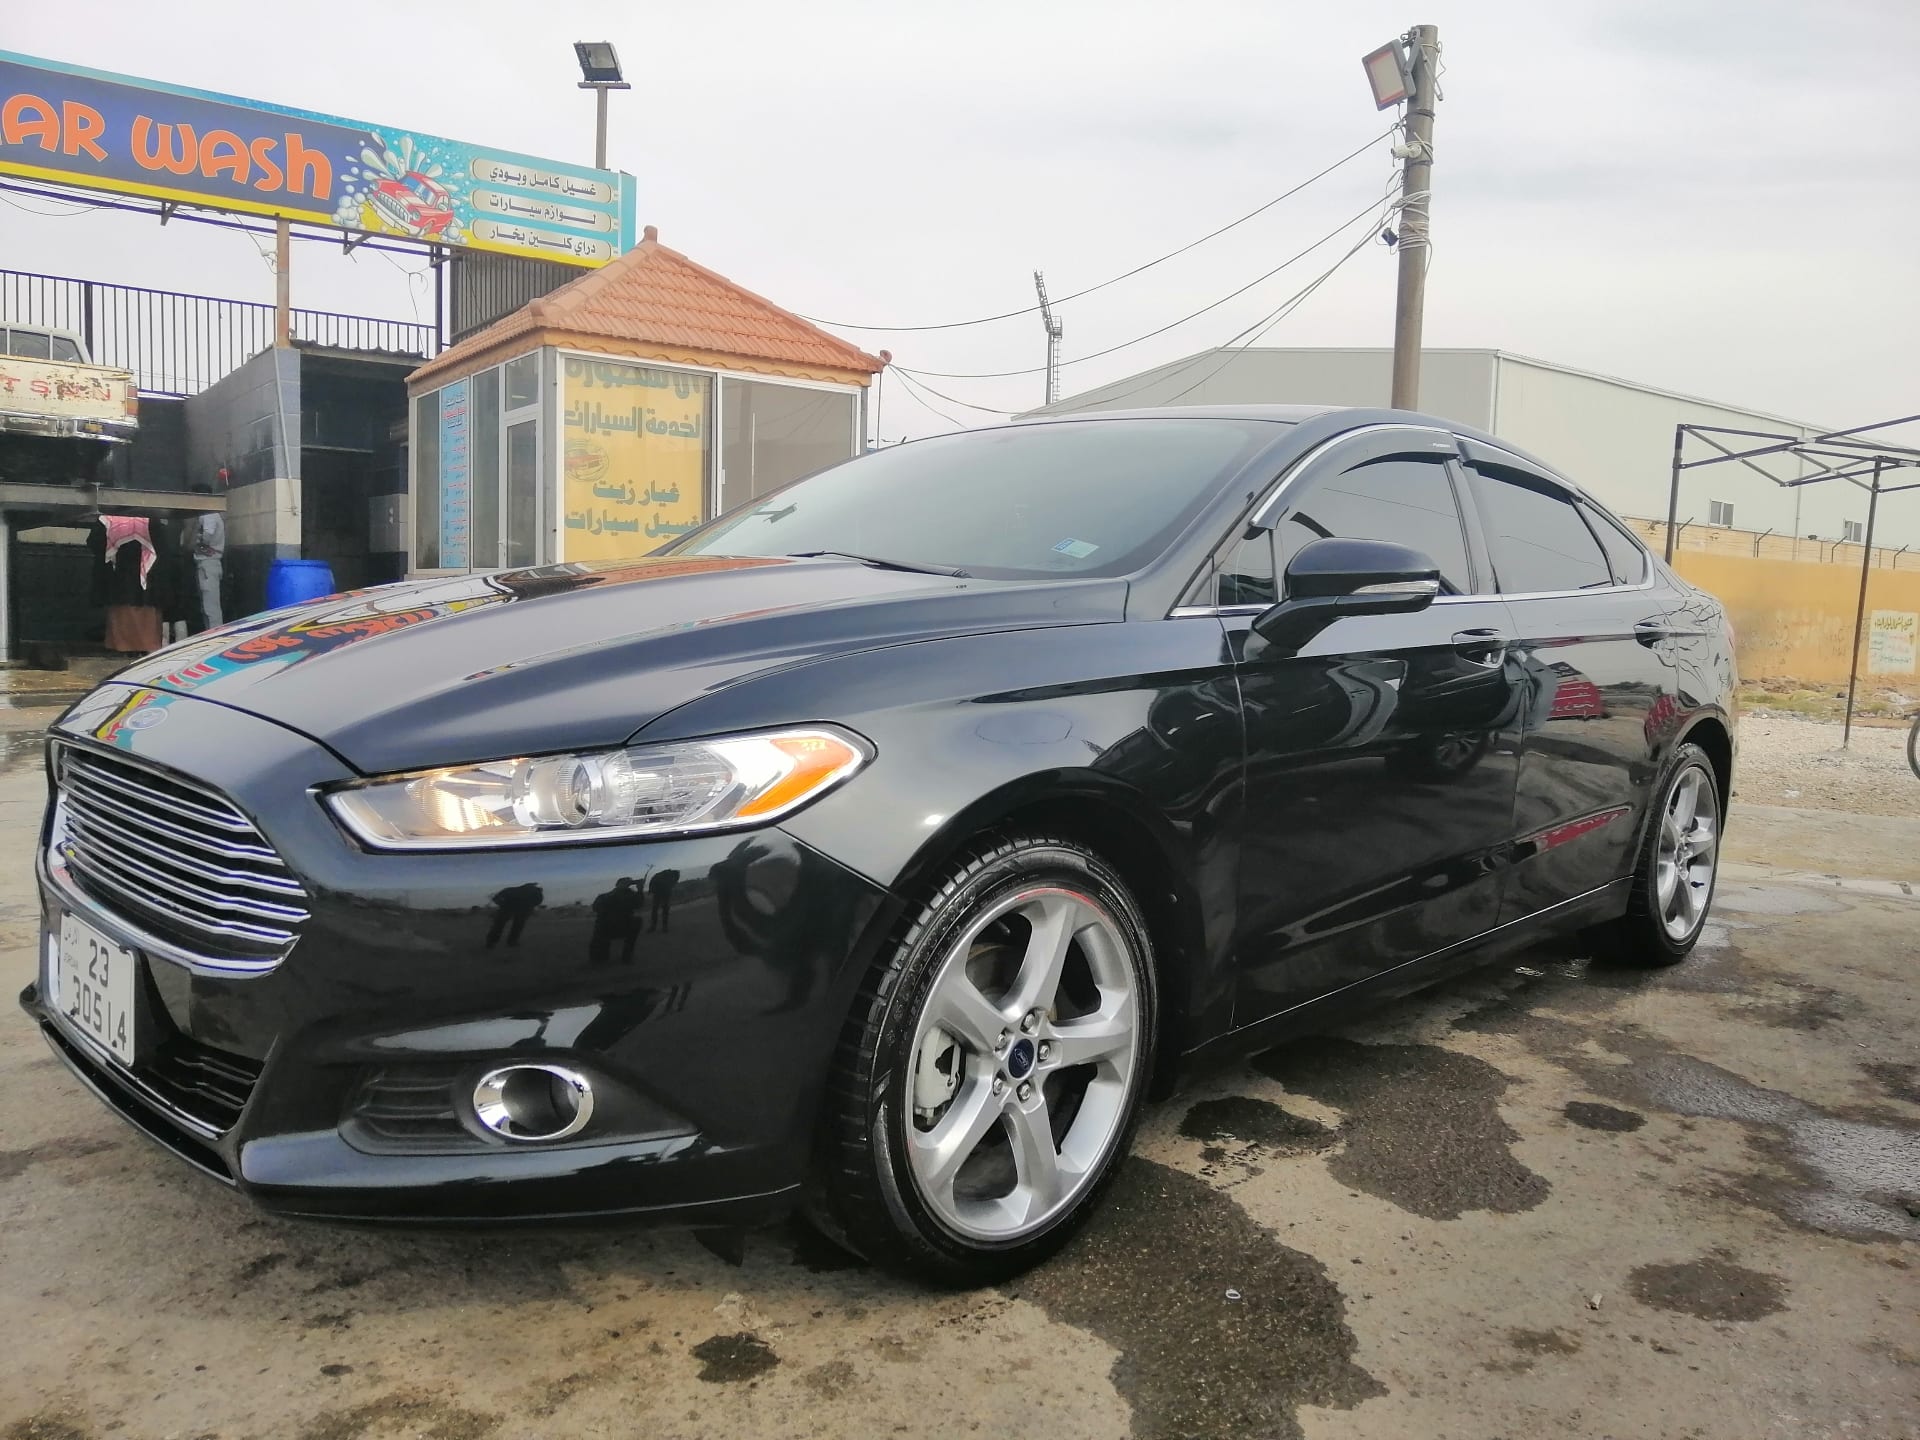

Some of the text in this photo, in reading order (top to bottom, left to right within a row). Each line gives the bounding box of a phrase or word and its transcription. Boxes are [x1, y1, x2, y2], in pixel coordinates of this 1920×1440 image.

[0, 94, 108, 162] AR
[529, 173, 560, 188] كامل
[562, 179, 597, 196] غسيل
[489, 195, 596, 225] لوازم سيارات
[489, 224, 596, 257] دراي كلين بخار
[593, 480, 680, 507] غيار زيت
[565, 508, 638, 535] سيارات
[89, 938, 109, 988] 23
